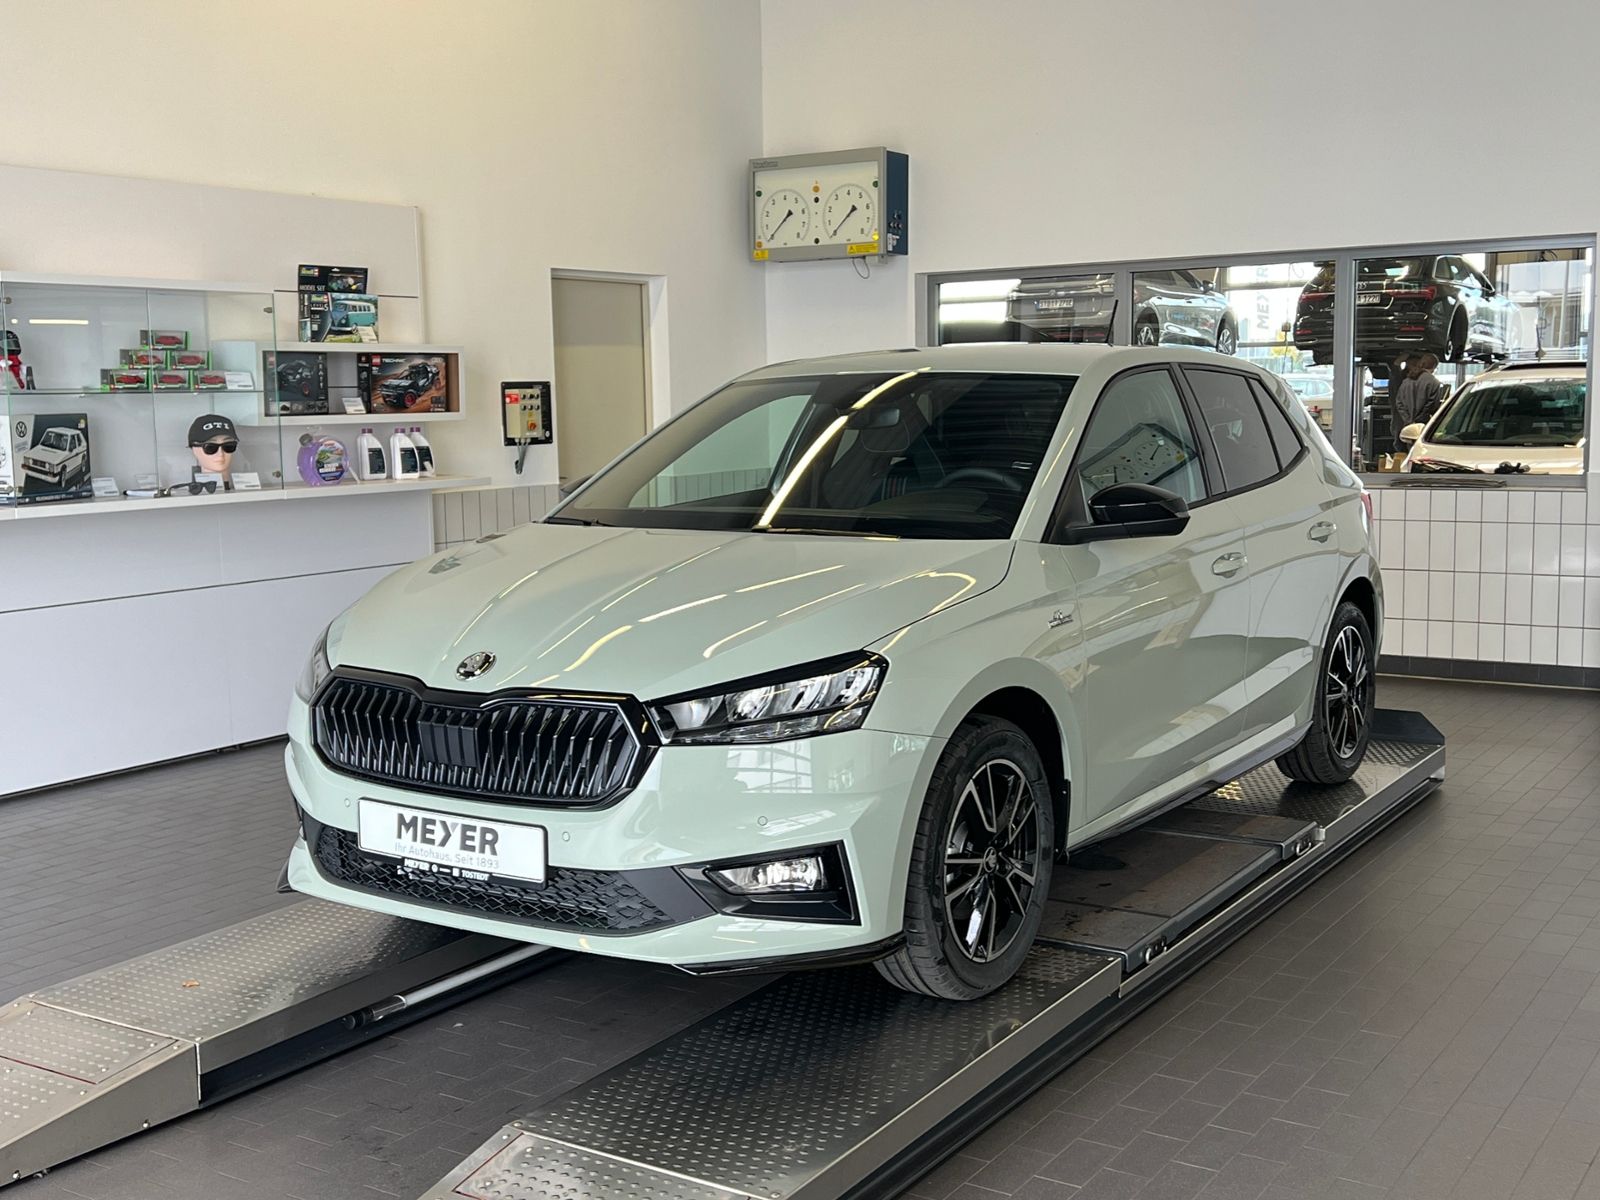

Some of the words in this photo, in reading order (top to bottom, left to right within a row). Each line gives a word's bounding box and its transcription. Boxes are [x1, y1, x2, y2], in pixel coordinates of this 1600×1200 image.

[1256, 266, 1270, 330] MEYR
[202, 422, 230, 430] GTI
[397, 813, 499, 856] MEYER
[395, 842, 407, 852] Ihr
[455, 854, 473, 865] Seit
[476, 857, 499, 869] 1893
[404, 858, 430, 871] MEYER
[461, 870, 489, 881] TOSTEDT
